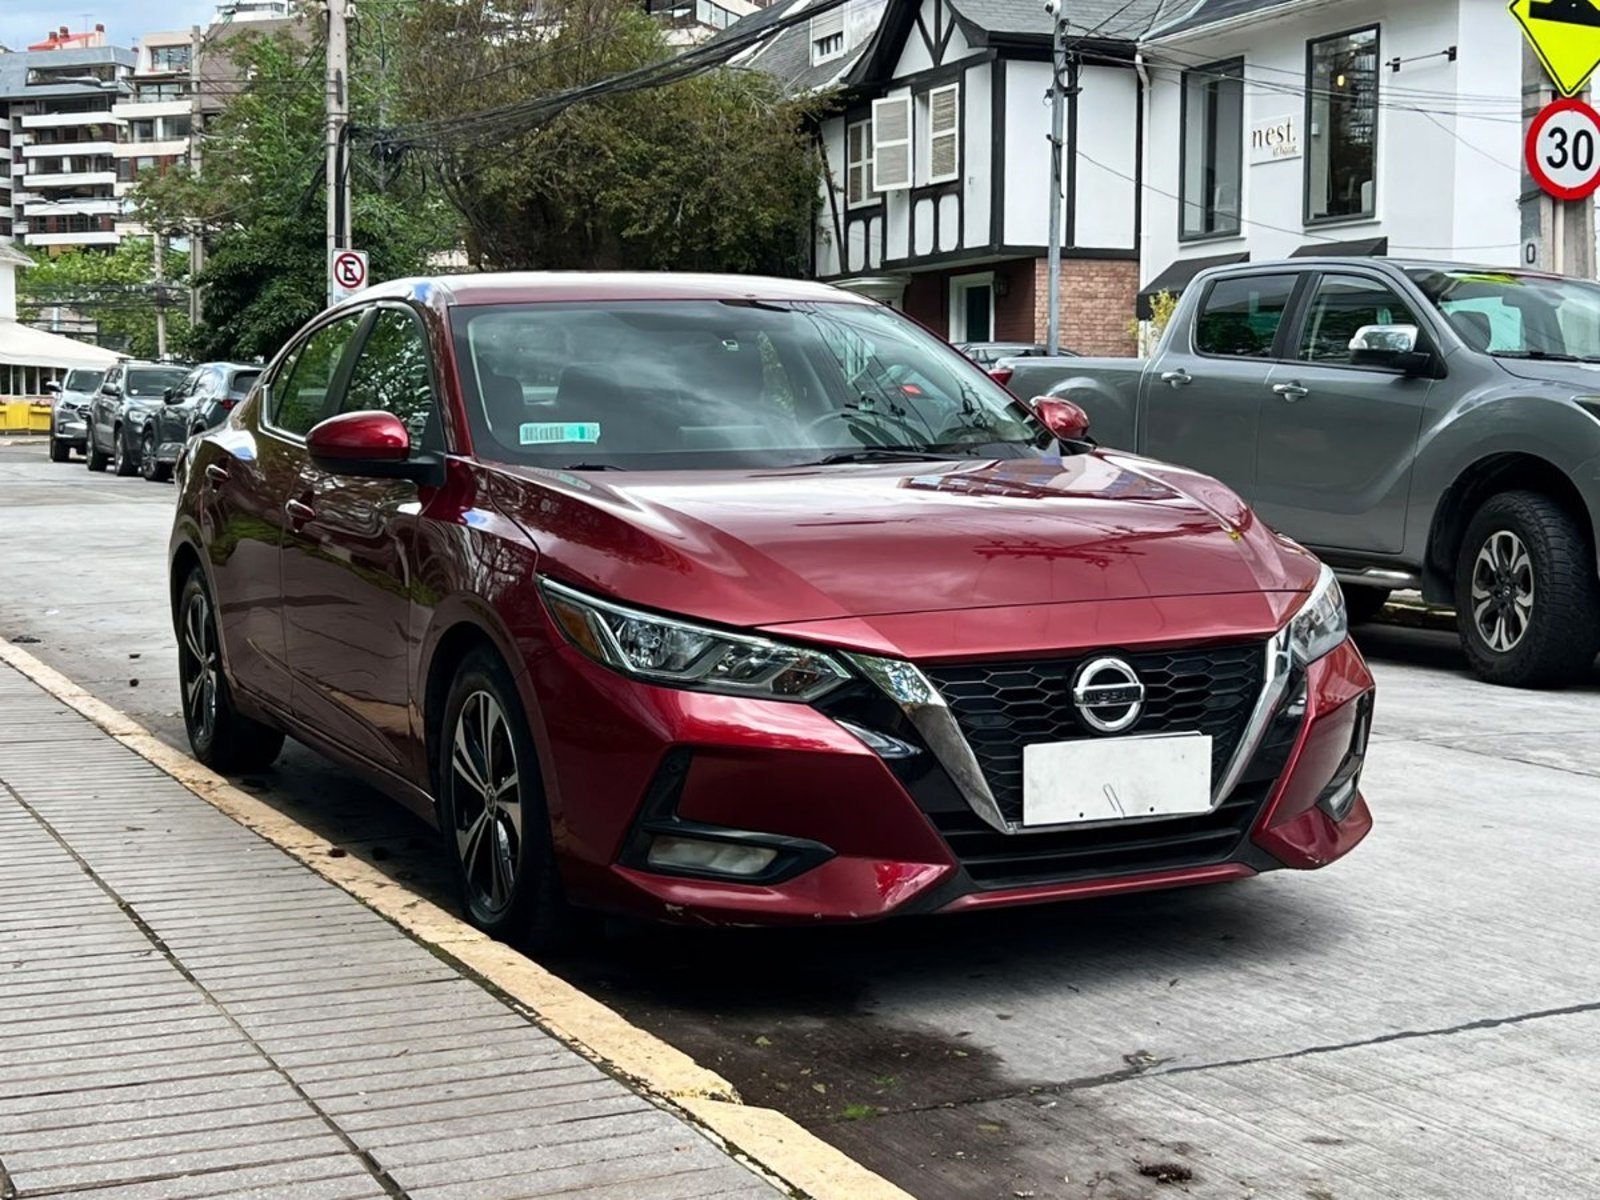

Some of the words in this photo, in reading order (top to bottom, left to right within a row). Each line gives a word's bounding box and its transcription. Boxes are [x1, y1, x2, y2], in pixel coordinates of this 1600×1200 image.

[1252, 116, 1296, 148] nest.
[1546, 126, 1594, 171] 30
[343, 260, 356, 281] E
